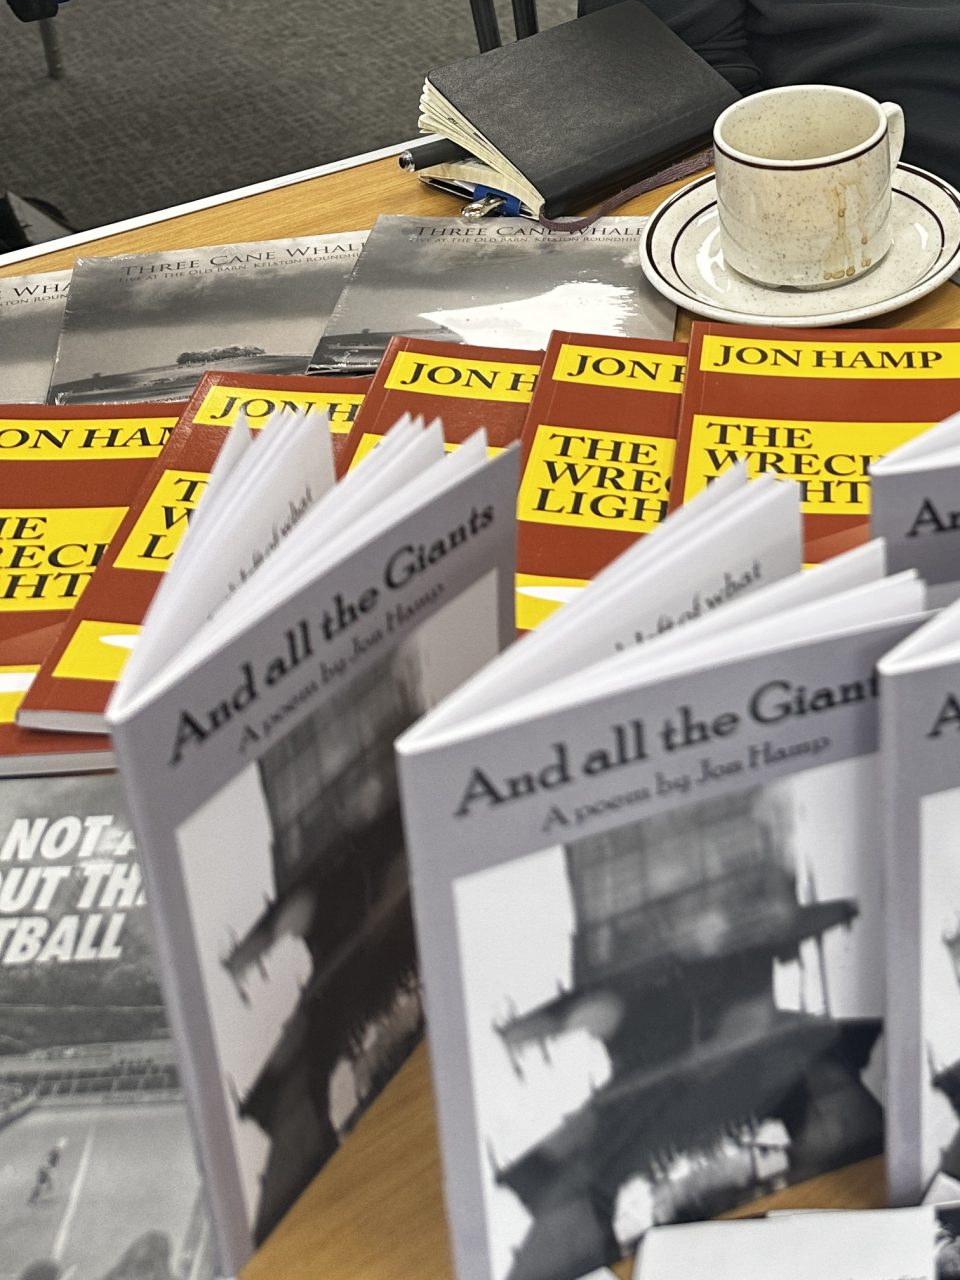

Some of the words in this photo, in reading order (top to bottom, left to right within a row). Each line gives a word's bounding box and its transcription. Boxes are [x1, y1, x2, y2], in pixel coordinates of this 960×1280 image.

[415, 226, 488, 236] THREE
[496, 226, 557, 236] CANE
[582, 235, 640, 243] ROUNDHIL
[121, 259, 200, 276] THREE
[210, 251, 275, 268] CANE
[164, 271, 186, 279] THE
[188, 267, 213, 276] OLD
[306, 253, 359, 263] ROUNDHI
[568, 354, 662, 381] JON
[712, 344, 803, 368] JON
[812, 350, 943, 369] HAMP
[400, 362, 501, 389] JON
[211, 396, 312, 421] JON
[0, 428, 70, 449] ON
[550, 433, 658, 466] THE
[706, 422, 813, 449] THE
[543, 460, 671, 494] WRE
[532, 488, 669, 523] LIGH
[705, 560, 761, 610] what
[168, 662, 259, 768] And
[264, 618, 315, 688] all
[320, 591, 380, 644] the
[383, 503, 496, 593] Giants
[453, 741, 571, 818] And
[581, 719, 649, 777] all
[659, 704, 740, 754] the
[750, 674, 880, 726] Giant
[541, 803, 568, 832] A
[573, 785, 651, 825] poem
[655, 771, 692, 796] by
[697, 757, 744, 784] Jon
[749, 733, 832, 770] Hamp
[0, 814, 115, 861] NOT
[0, 865, 73, 913] UT
[77, 860, 147, 909] TH
[0, 912, 127, 965] TBALL
